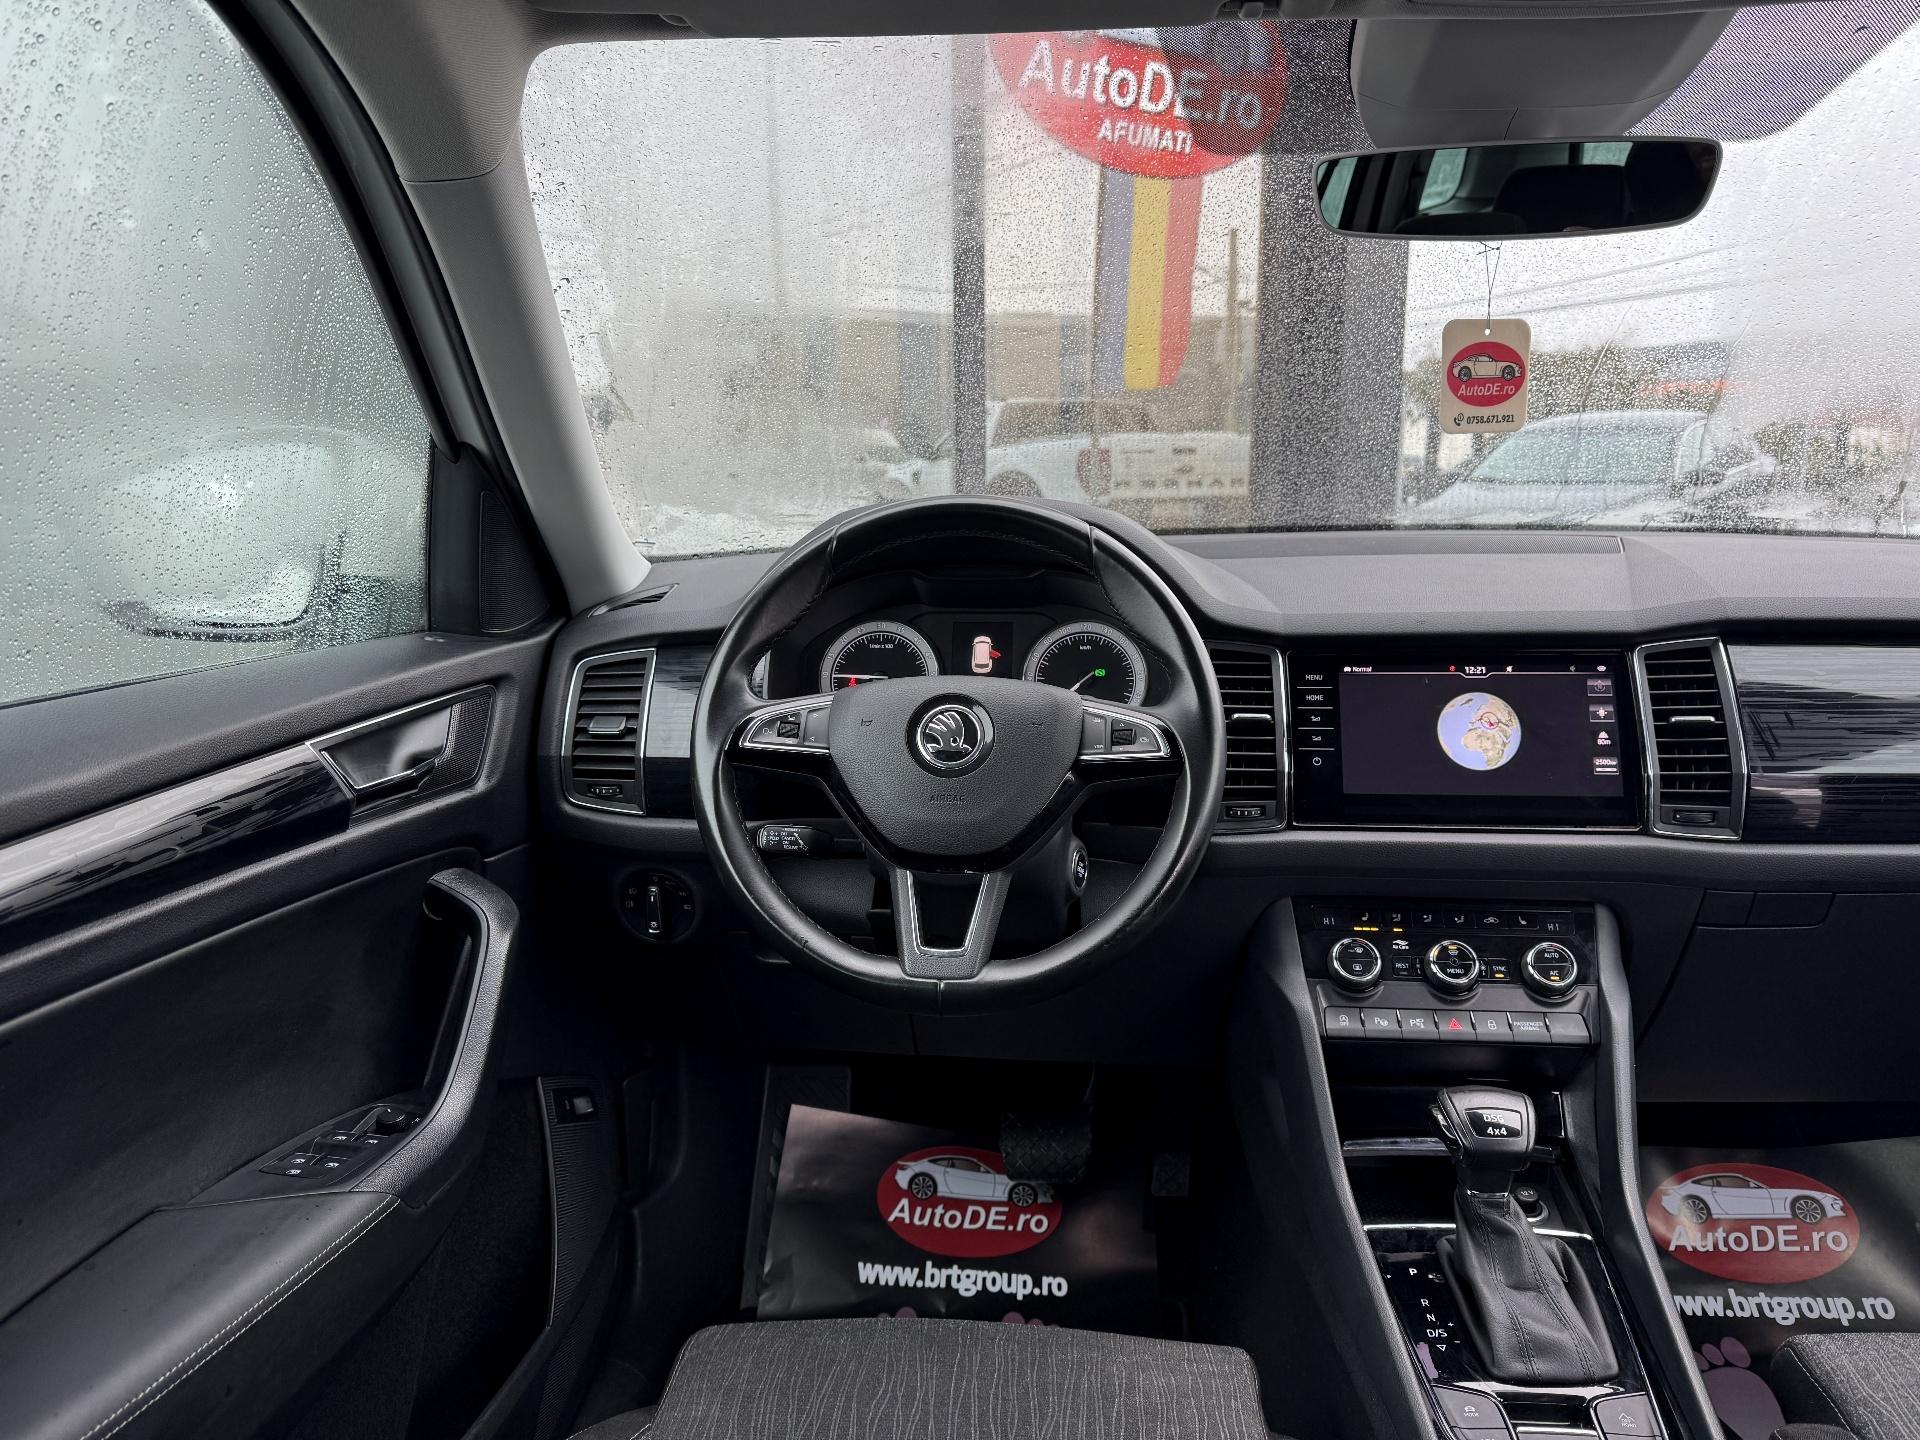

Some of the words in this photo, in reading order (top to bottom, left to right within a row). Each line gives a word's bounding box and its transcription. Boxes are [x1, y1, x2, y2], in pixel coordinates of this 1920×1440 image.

[1018, 39, 1262, 130] AutoDE.ro
[1457, 382, 1515, 397] AutoDE.ro
[1466, 414, 1515, 425] 0758.671.921
[1464, 666, 1487, 674] 12:21
[1483, 1113, 1505, 1122] DSG
[1486, 1126, 1508, 1136] 4x4
[887, 1197, 1049, 1234] AutoDE.ro
[1668, 1224, 1849, 1253] AutoDE.ro
[1408, 1267, 1418, 1276] P
[857, 1260, 1068, 1301] www.brtgroup.ro
[1420, 1298, 1430, 1307] R
[1673, 1287, 1896, 1327] ww.brtgroup.ro
[1426, 1313, 1436, 1322] N
